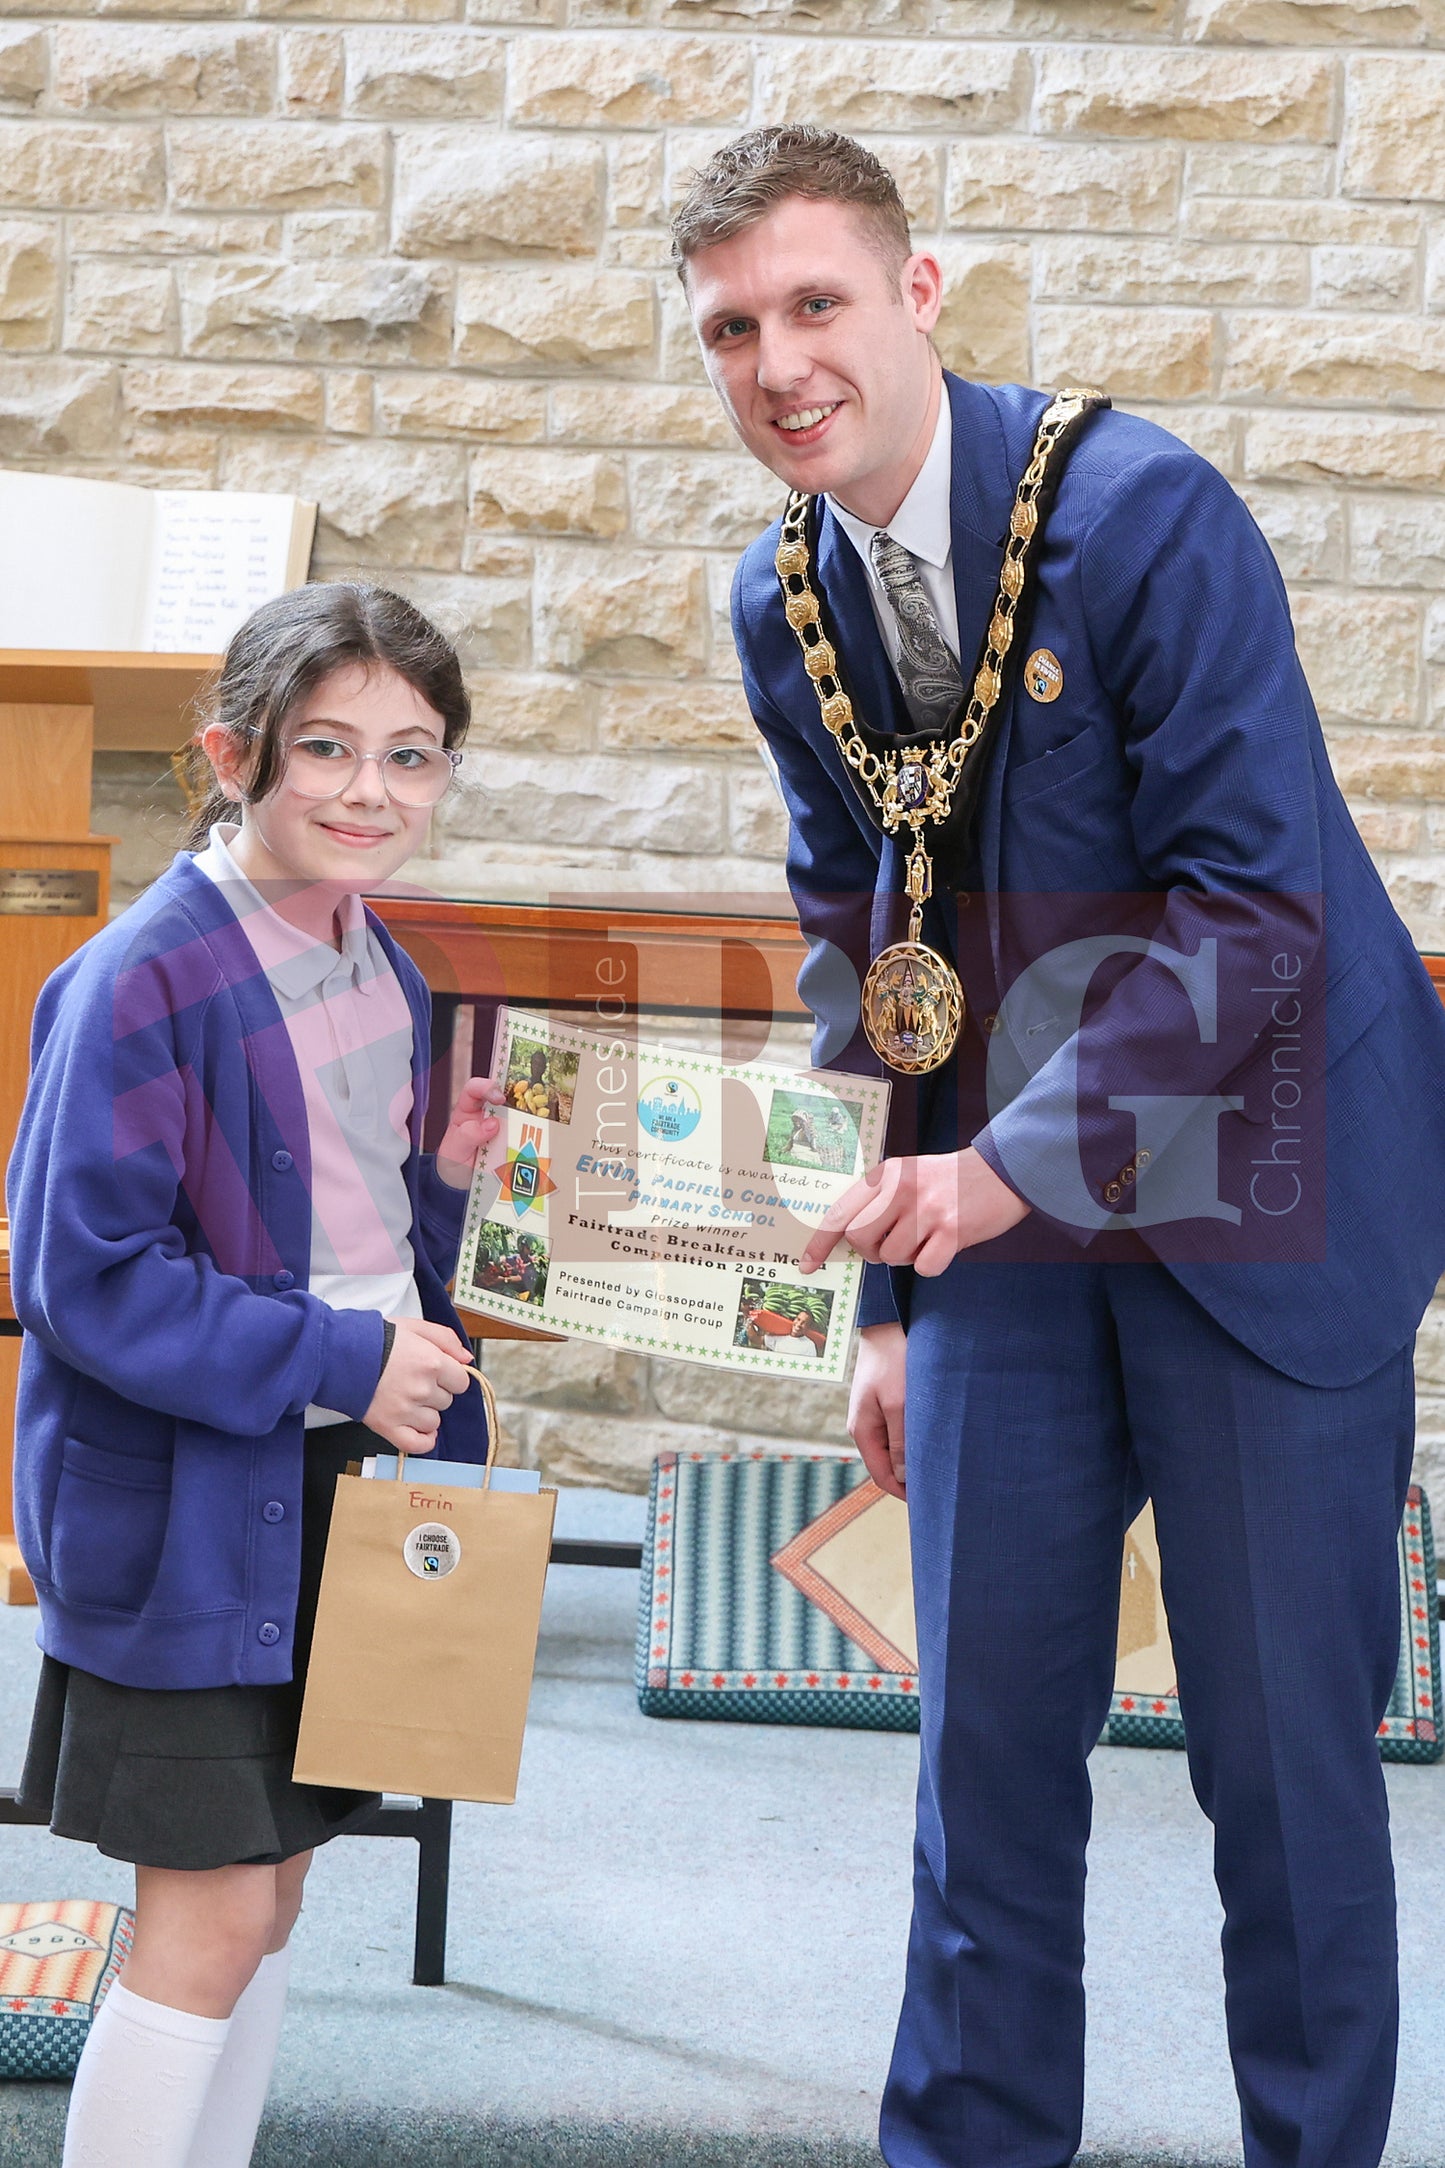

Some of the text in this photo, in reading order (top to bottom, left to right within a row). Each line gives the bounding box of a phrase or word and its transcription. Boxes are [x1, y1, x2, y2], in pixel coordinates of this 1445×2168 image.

[652, 1119, 680, 1130] FAIRTRADE
[591, 1139, 832, 1190] This certificate is awarded to
[575, 1154, 641, 1187] Errin,
[740, 1188, 832, 1215] COMMUNIT
[627, 1189, 776, 1227] PRIMARY SCHOOL
[650, 1214, 748, 1239] Prize winner
[567, 1213, 827, 1271] Fairtrade Breakfast Meu
[610, 1239, 777, 1279] Competition 2026
[555, 1286, 724, 1330] Fairtrade Campaign Group
[559, 1270, 725, 1312] Presented by Glossopdale
[409, 1491, 453, 1511] Errin
[415, 1542, 450, 1553] FAIRTRADE
[422, 1534, 448, 1544] CHOOSE
